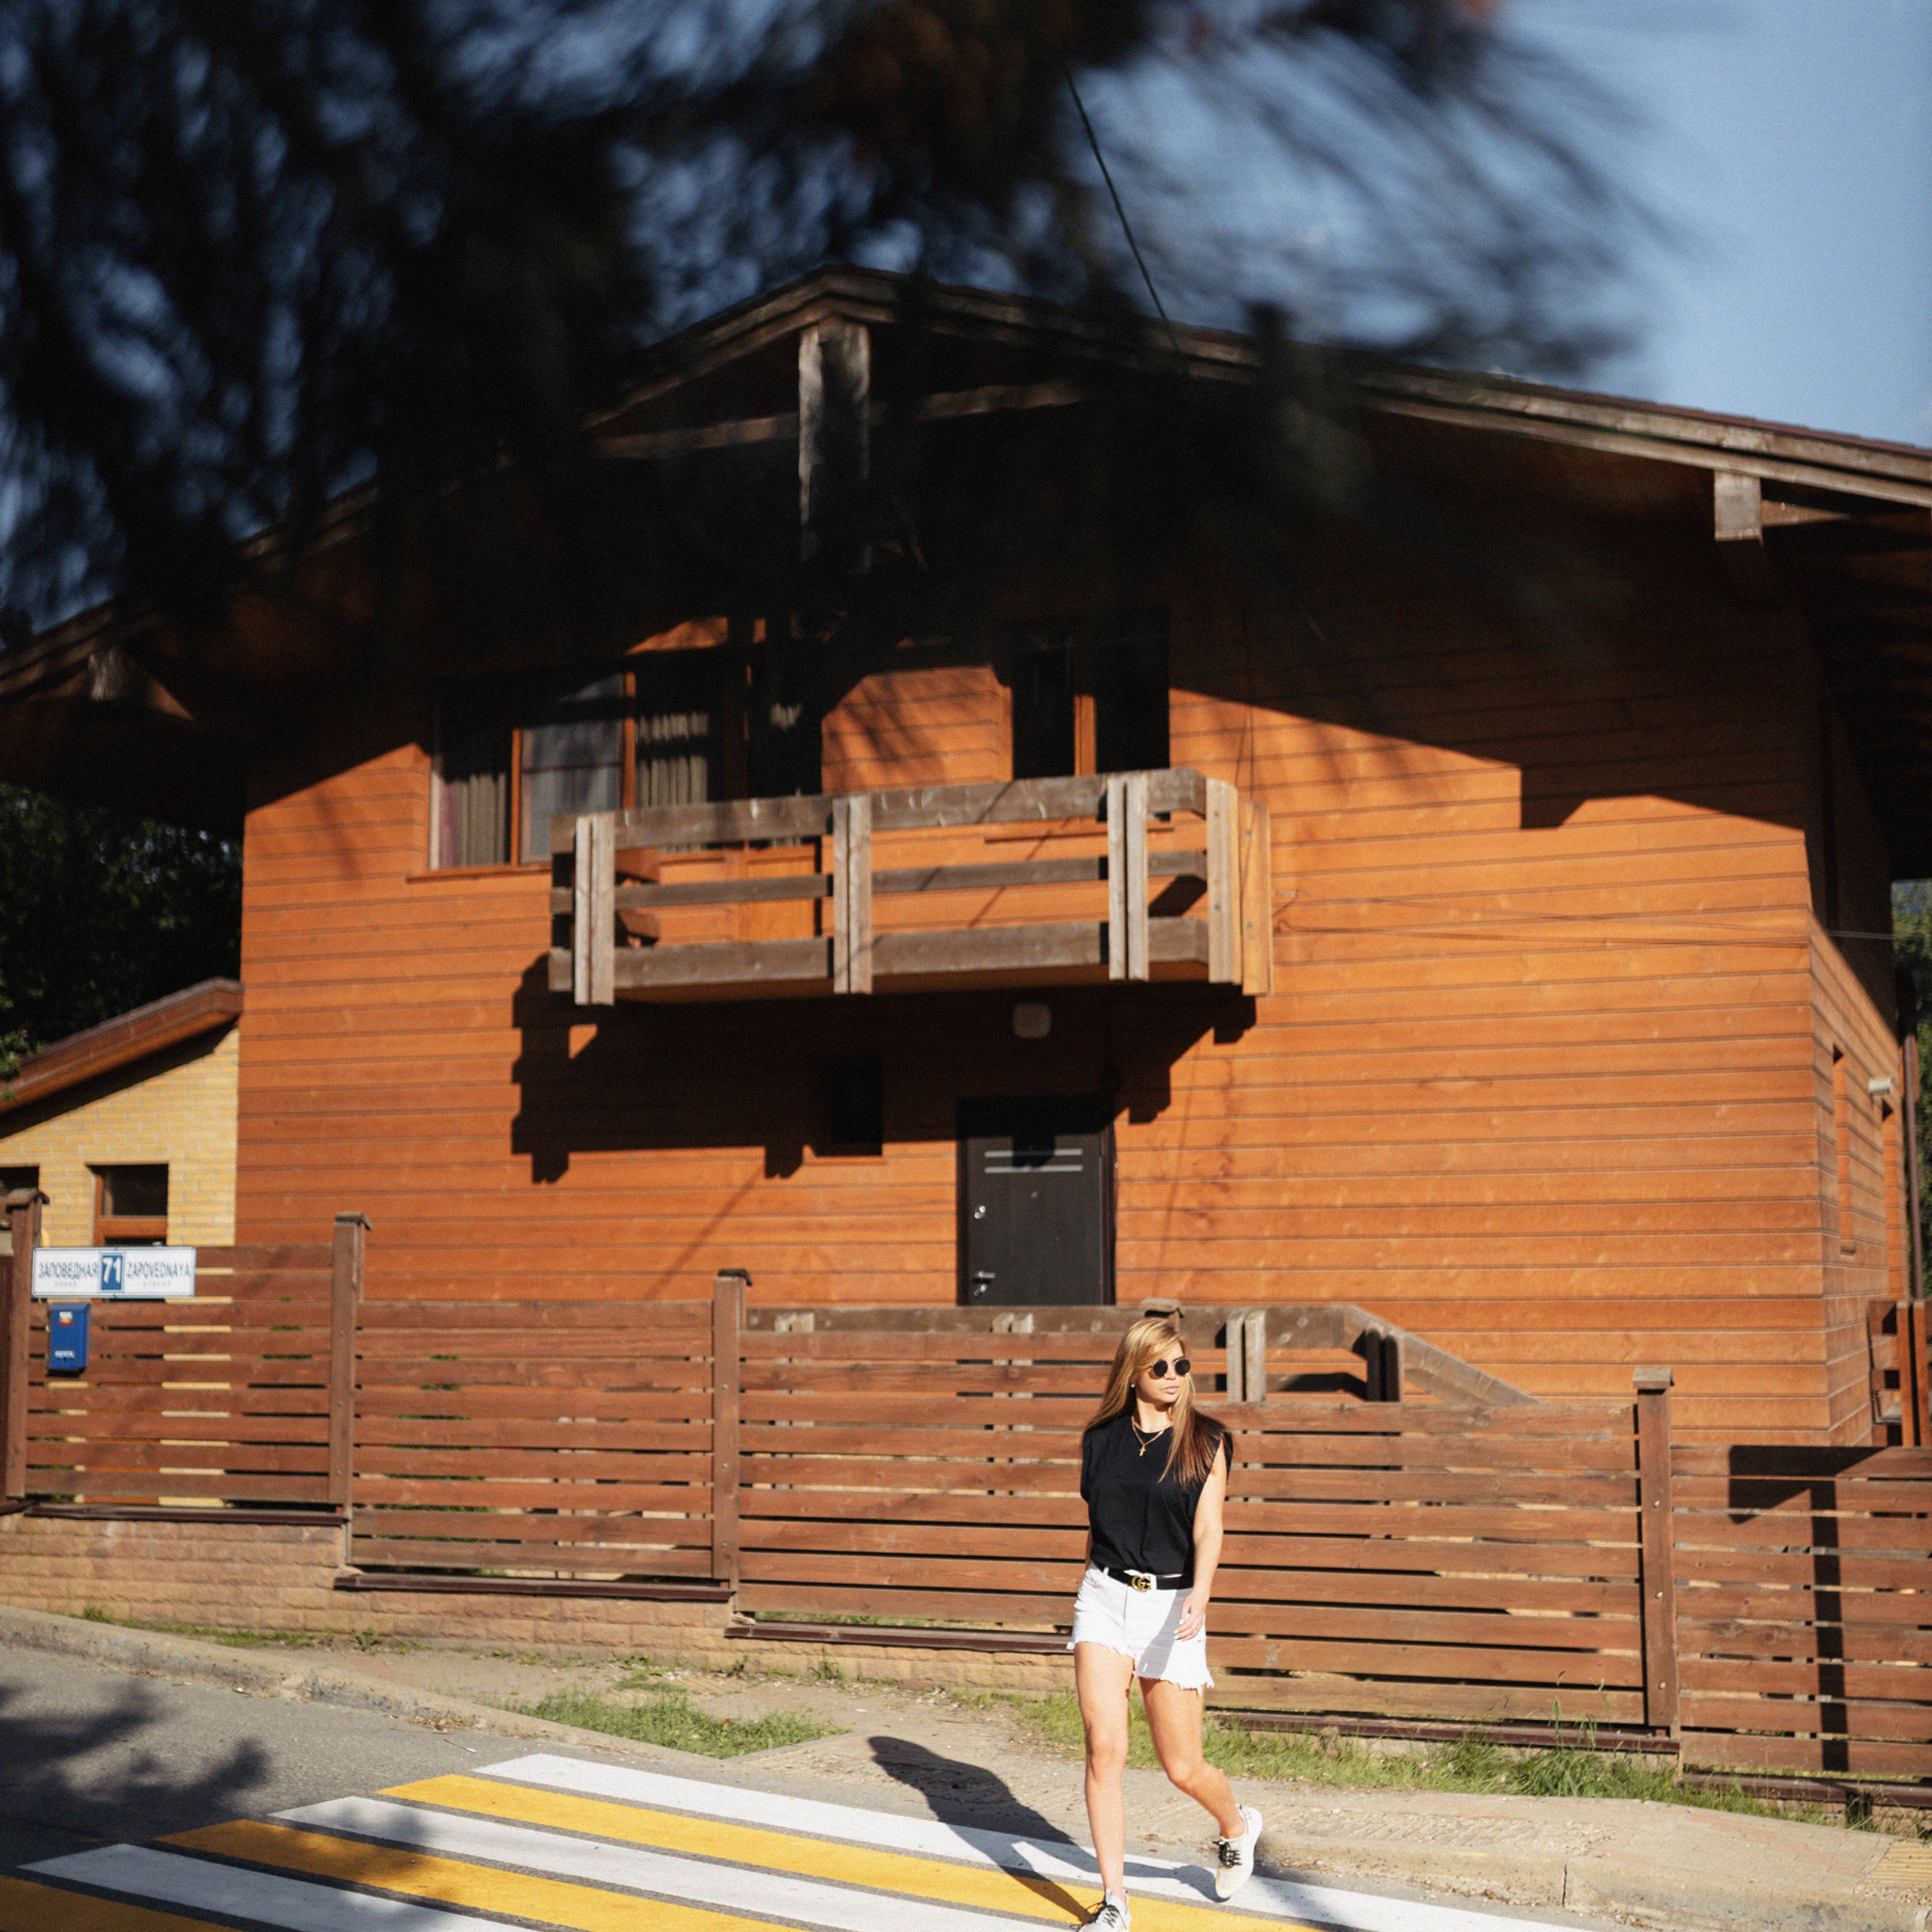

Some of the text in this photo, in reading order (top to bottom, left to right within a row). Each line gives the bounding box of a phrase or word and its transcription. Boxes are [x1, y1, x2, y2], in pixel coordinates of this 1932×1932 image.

[38, 1262, 98, 1279] ЗАПОВЕДНАЯ
[103, 1257, 122, 1283] 71
[127, 1261, 189, 1278] ZAPOVEDNAYA
